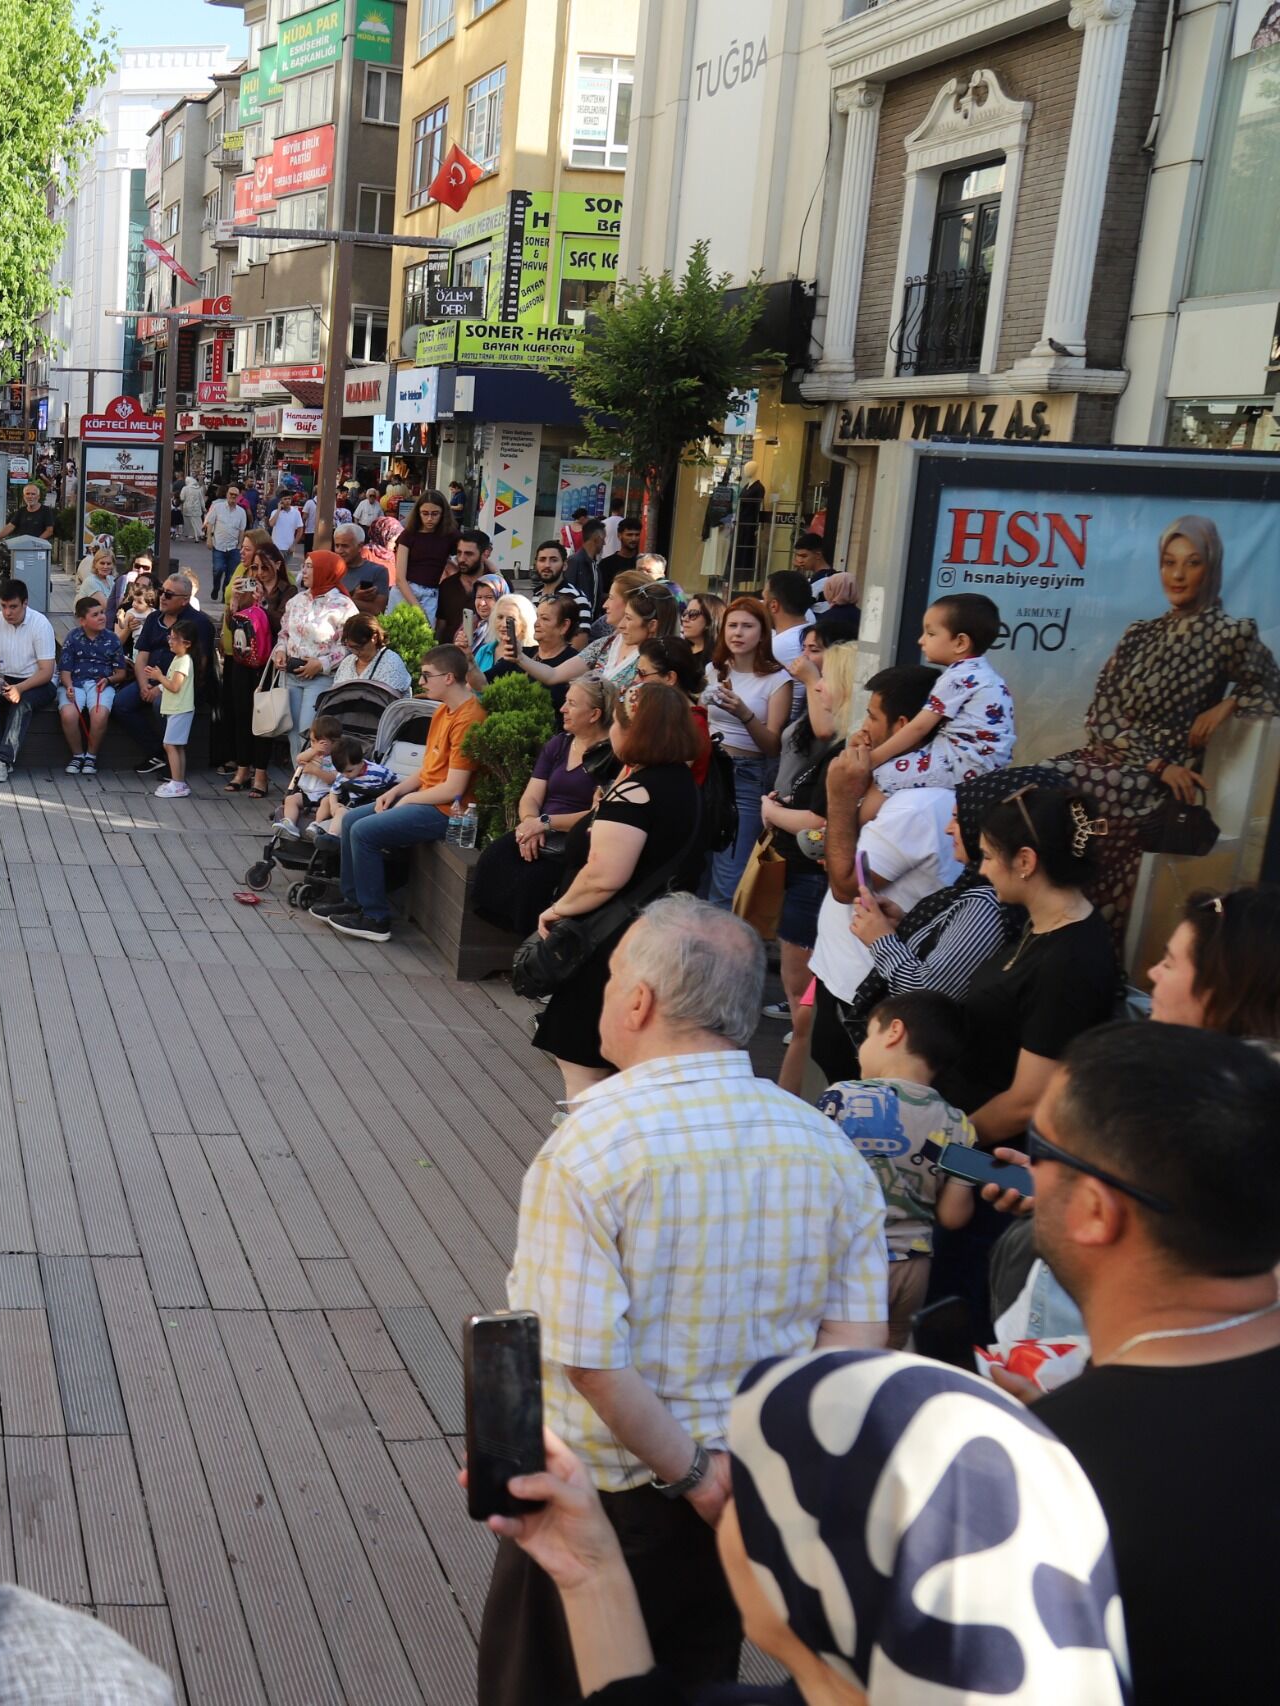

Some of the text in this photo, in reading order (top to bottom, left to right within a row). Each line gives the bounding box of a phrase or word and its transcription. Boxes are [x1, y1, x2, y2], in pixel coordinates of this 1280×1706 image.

[282, 12, 338, 46] HÜDA PAR
[289, 34, 330, 57] ESKİŞEHİR
[290, 45, 336, 69] BAŞKANLIĞI
[696, 35, 768, 101] TUĞBA
[282, 140, 302, 156] BÜYÜK
[524, 236, 550, 248] SONER
[533, 249, 540, 259] &
[569, 251, 597, 271] SAÇ
[436, 288, 473, 302] ÖZLEM
[520, 278, 545, 298] BAYAN
[441, 303, 467, 316] DERİ
[465, 325, 524, 341] SONER
[482, 342, 520, 352] BAYAN
[84, 418, 163, 431] KÖFTECİ MELİH
[294, 422, 317, 431] Büfe
[911, 401, 999, 440] YILMAZ
[942, 508, 1094, 570] HSN
[963, 570, 1086, 590] hsnabiyegiyim
